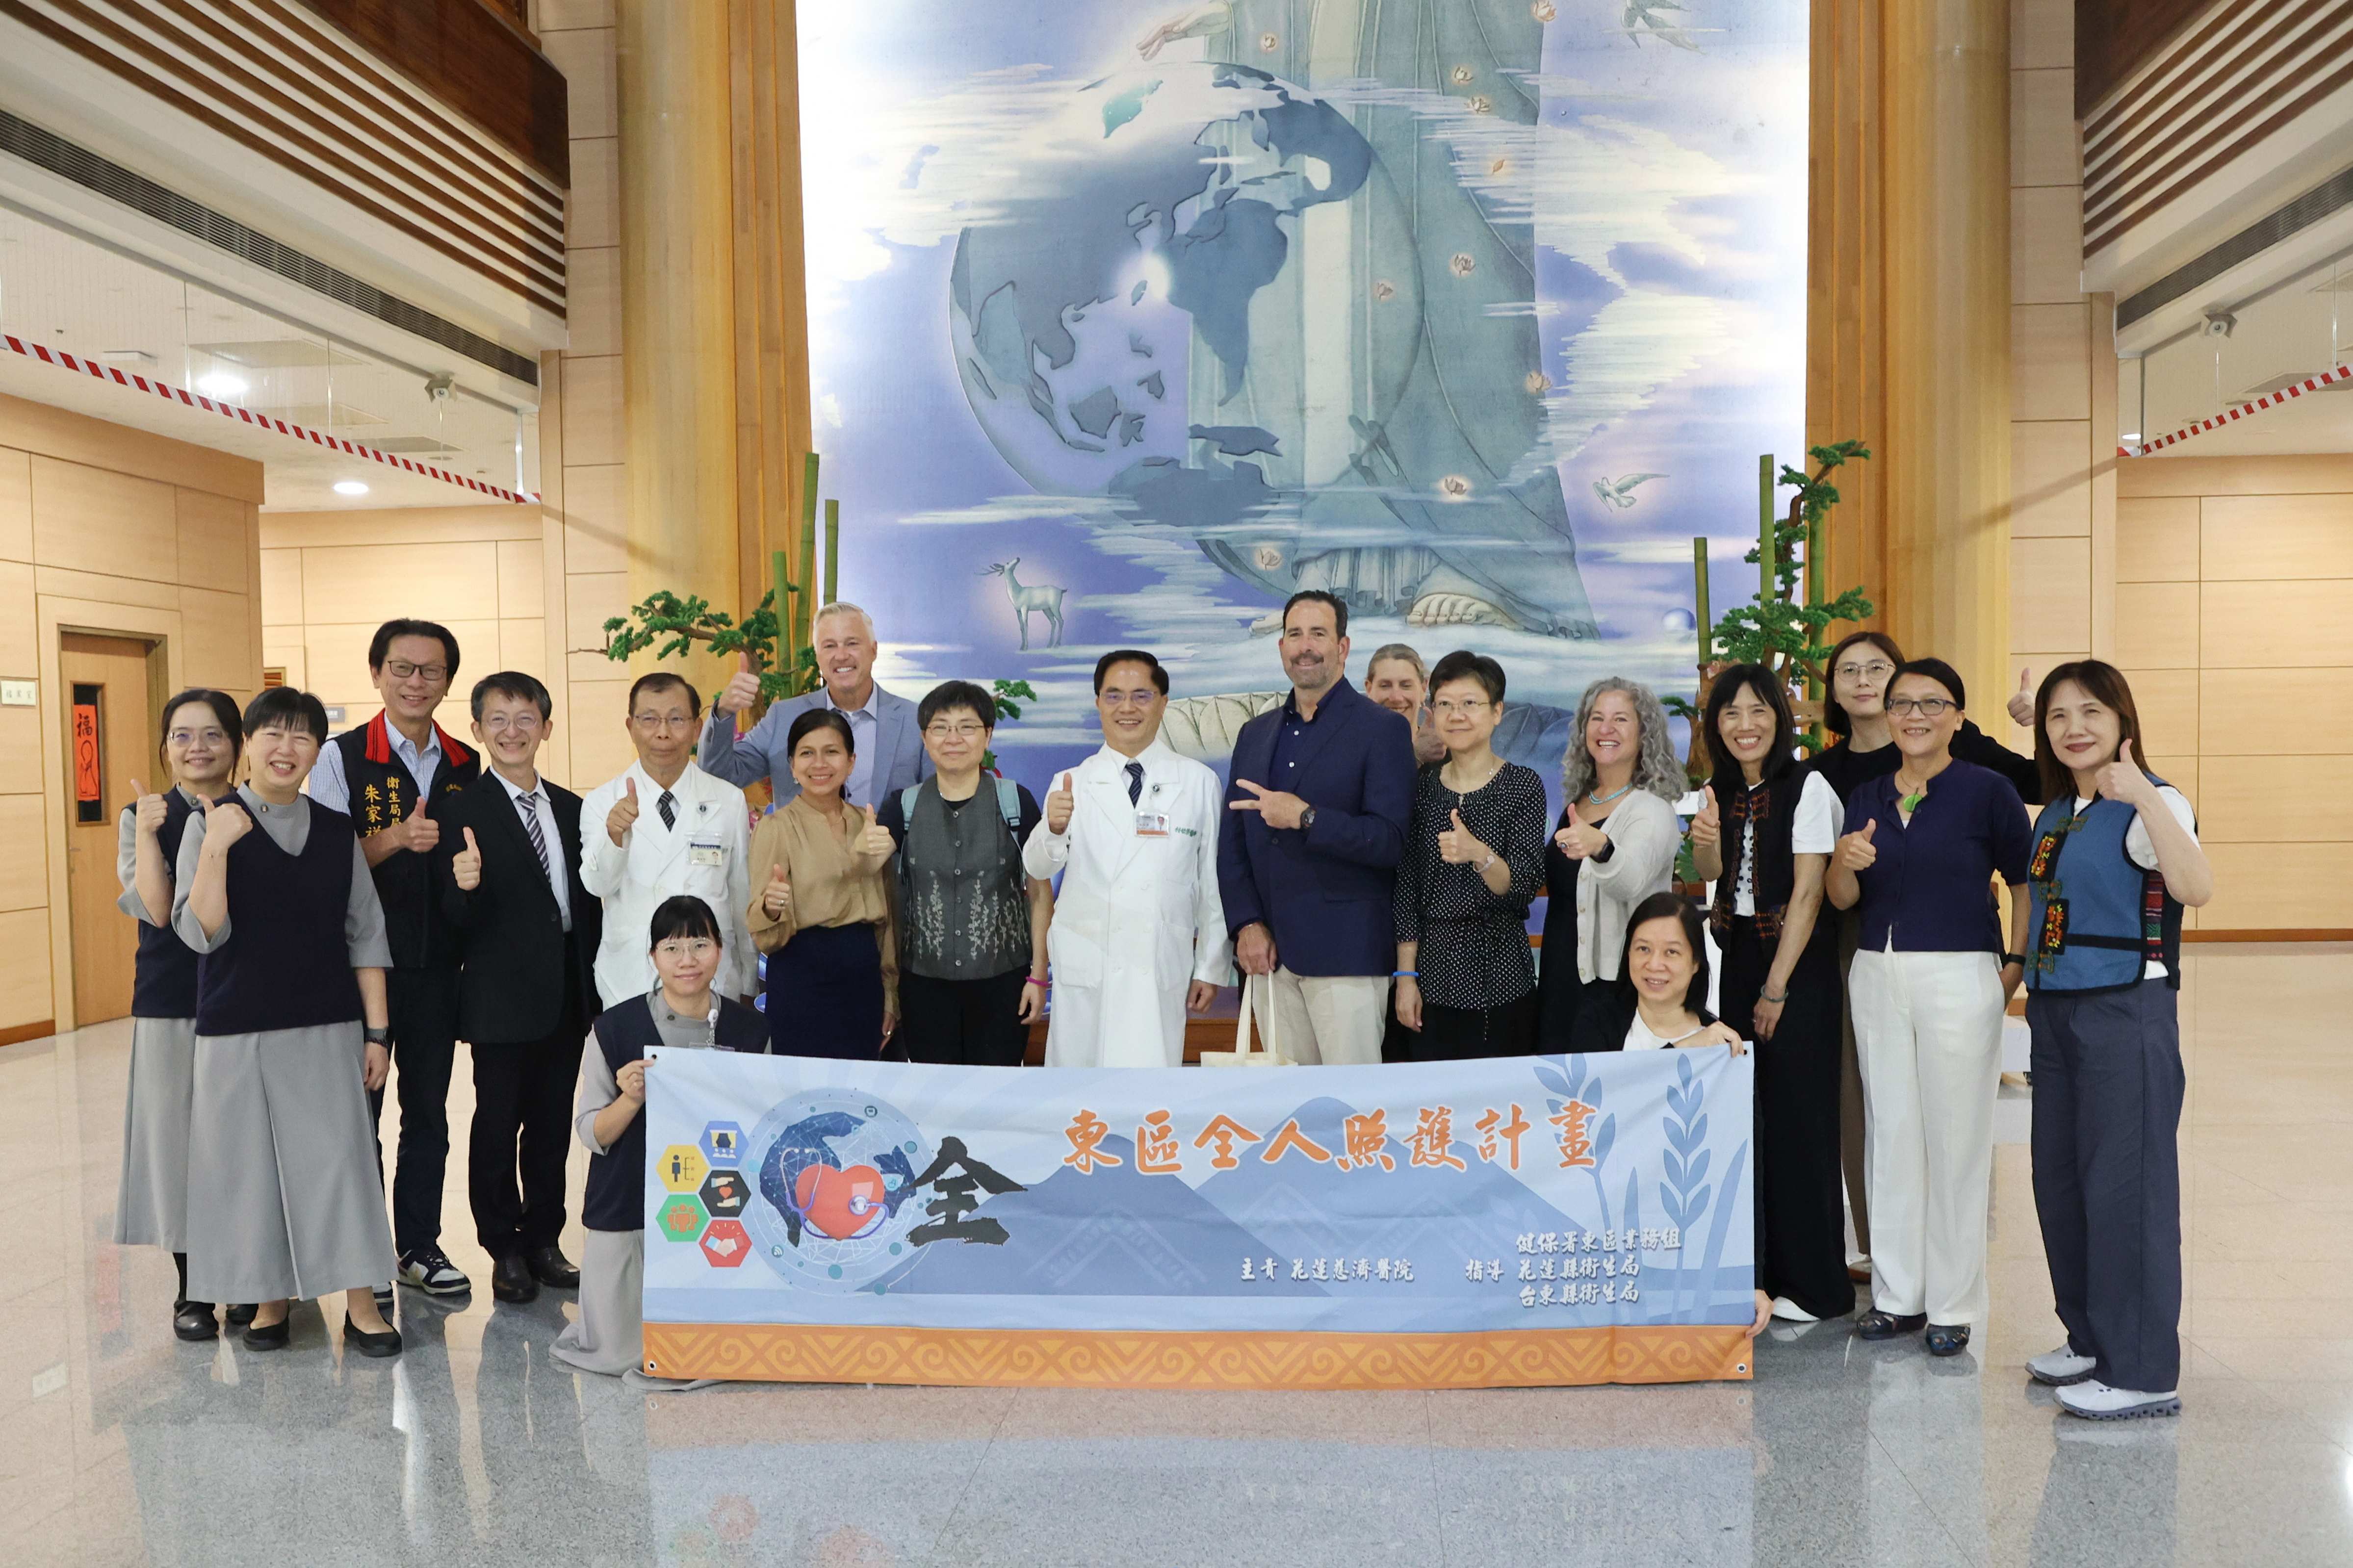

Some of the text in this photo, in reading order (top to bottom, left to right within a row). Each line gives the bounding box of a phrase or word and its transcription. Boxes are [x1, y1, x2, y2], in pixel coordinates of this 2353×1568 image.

[77, 713, 93, 738] 福
[1063, 1101, 1598, 1175] 東區全人照護計畫
[905, 1135, 1029, 1247] 全
[1515, 1228, 1681, 1254] 健保署東區業務組
[1241, 1257, 1415, 1282] 主責 花蓮慈濟醫院
[1466, 1255, 1639, 1282] 指導 花蓮縣衛生局
[1519, 1280, 1639, 1307] 台東縣衛生局
